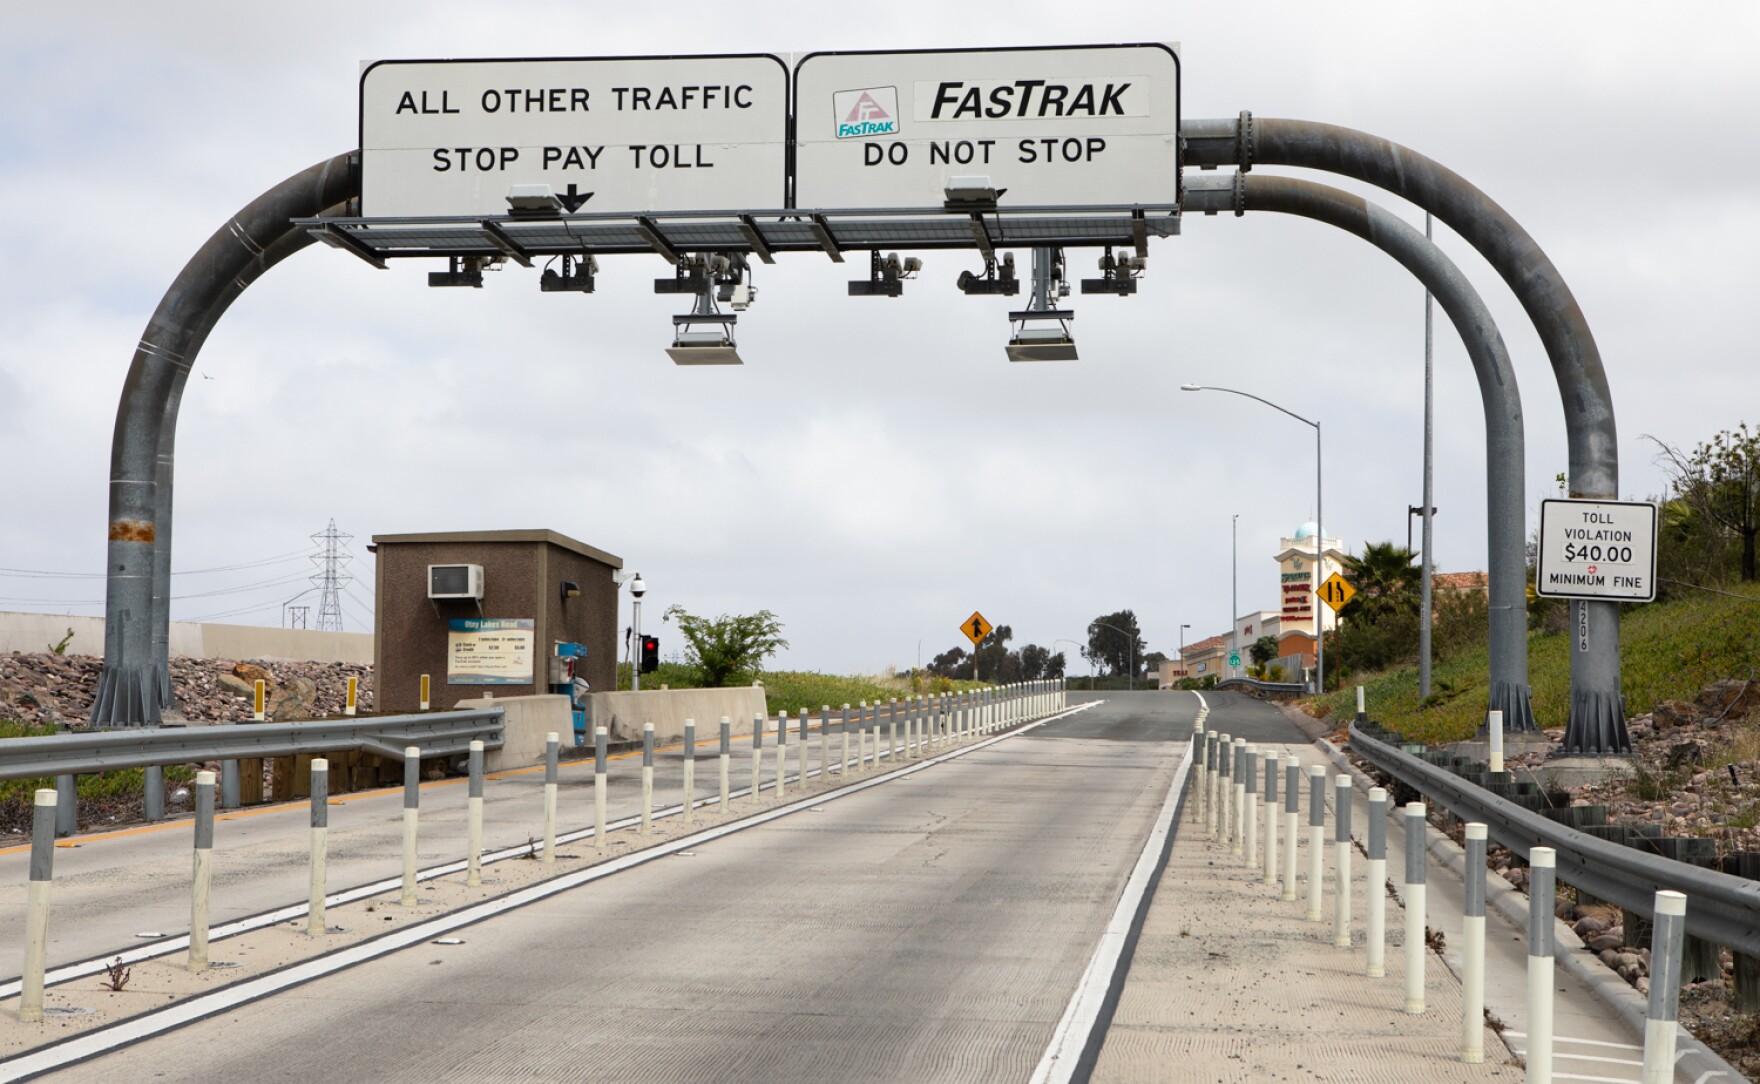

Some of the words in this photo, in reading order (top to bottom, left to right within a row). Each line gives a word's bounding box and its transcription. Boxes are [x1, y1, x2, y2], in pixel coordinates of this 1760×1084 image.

[396, 90, 460, 115] ALL
[481, 88, 590, 114] OTHER
[611, 84, 753, 111] TRAFFIC
[433, 147, 520, 172] STOP
[543, 145, 605, 171] PAY
[629, 143, 714, 169] TOLL
[864, 141, 909, 167] DO
[930, 140, 996, 165] NOT
[1018, 137, 1107, 164] STOP
[1583, 512, 1614, 525] TOLL
[1564, 528, 1632, 542] VIOLATION
[1564, 542, 1632, 563] $40.00
[1549, 572, 1605, 587] MINIMUM
[1613, 576, 1642, 589] FINE
[480, 620, 500, 628] Lakes
